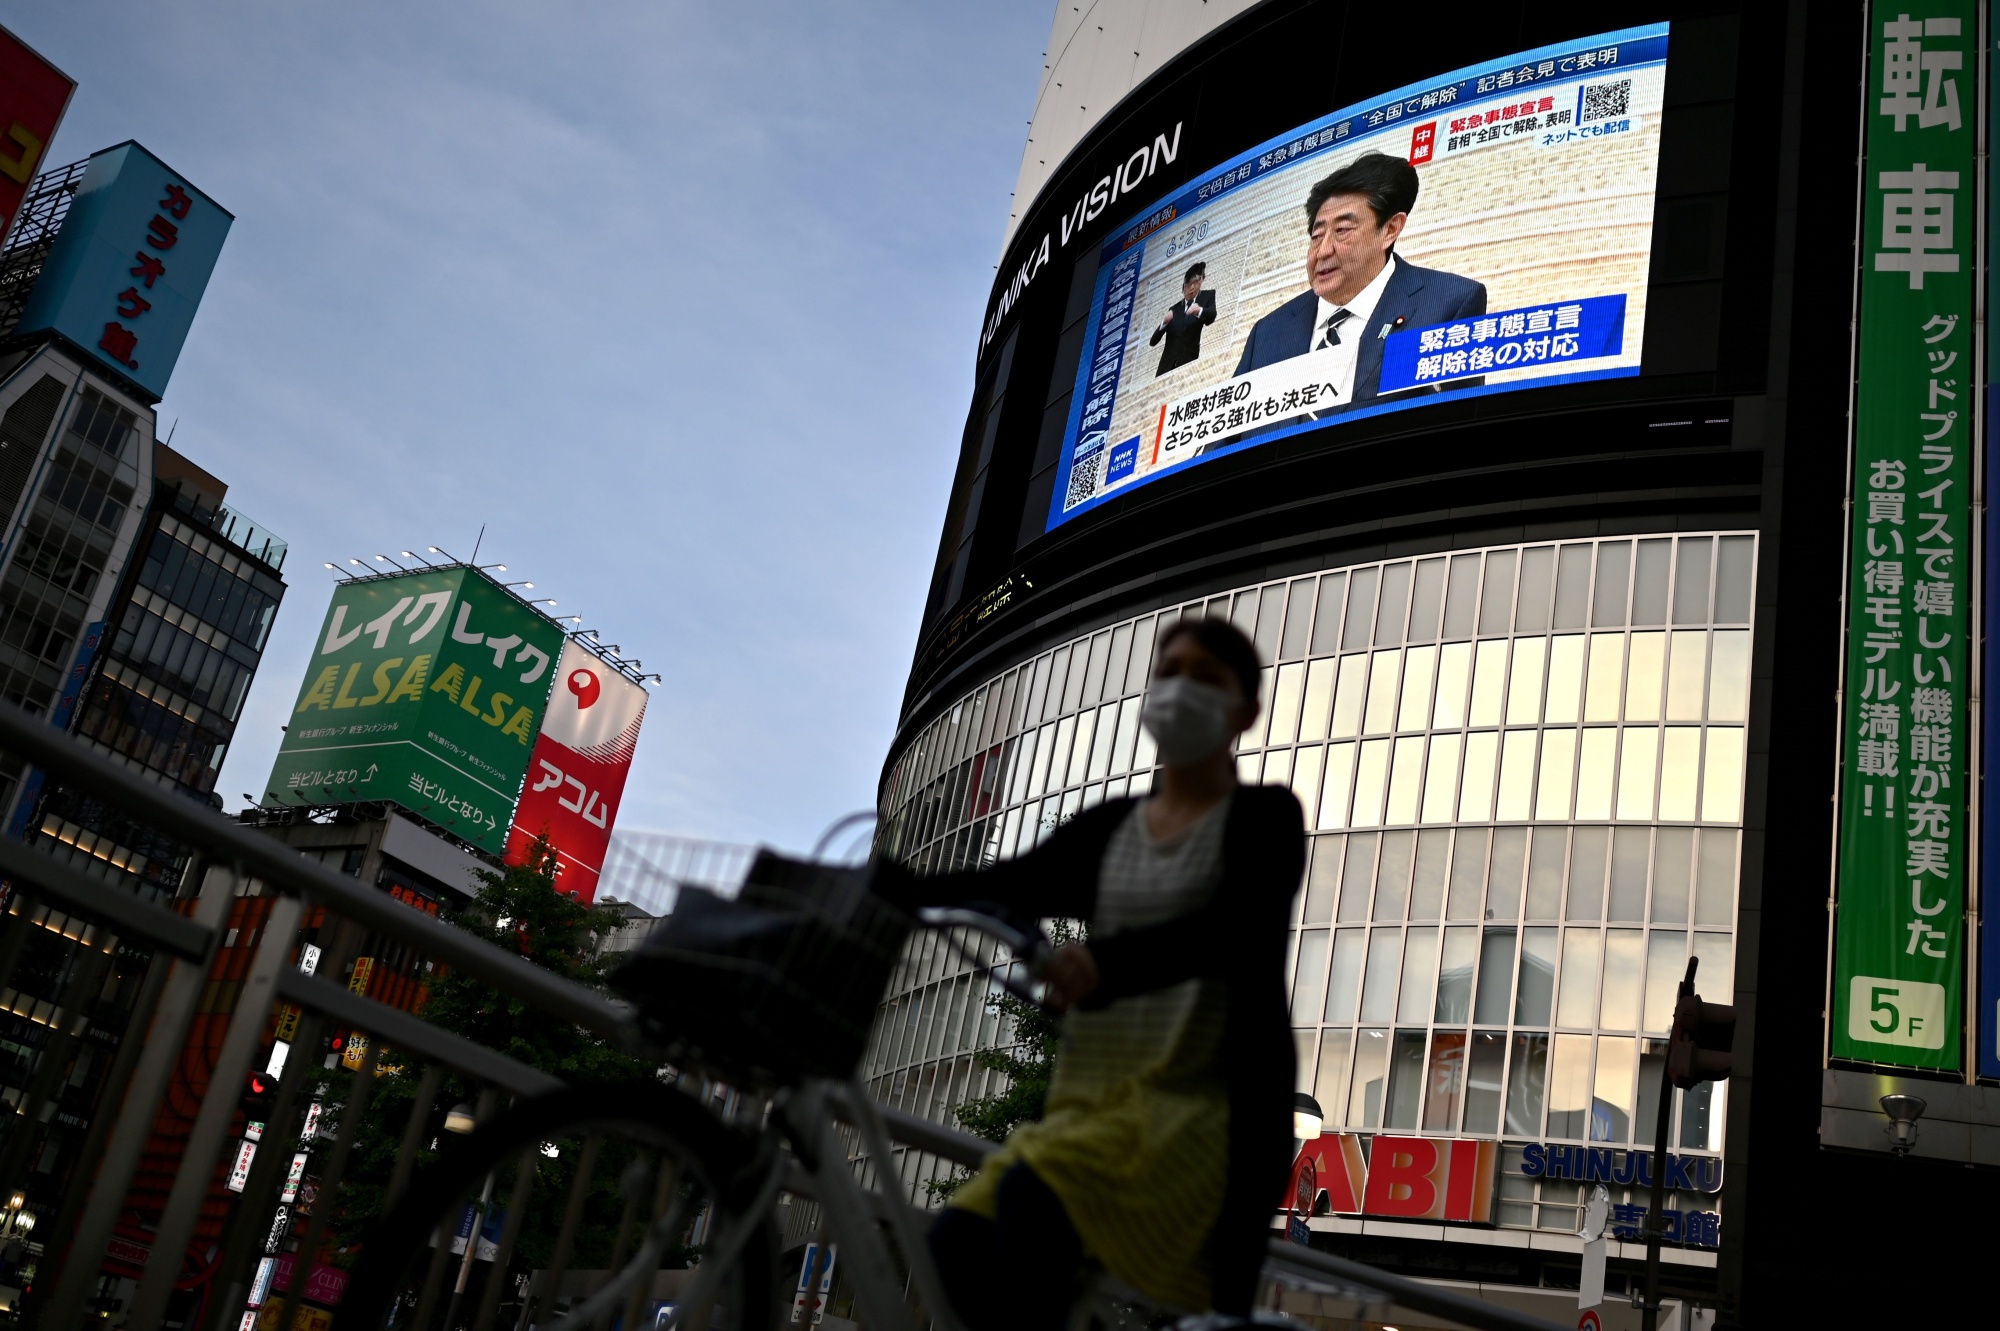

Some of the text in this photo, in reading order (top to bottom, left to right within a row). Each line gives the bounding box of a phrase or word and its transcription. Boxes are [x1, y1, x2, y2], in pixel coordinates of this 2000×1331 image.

[1197, 162, 1251, 203] 安倍首相
[1258, 121, 1351, 172] 緊急事態宣言
[1476, 47, 1618, 94] 記者会見で表明
[1450, 96, 1555, 134] 緊急事態宣言
[1542, 119, 1631, 146] ネットでも配信
[1412, 129, 1431, 159] 中継
[1875, 14, 1962, 290] 転車
[1061, 121, 1182, 248] VISION
[1166, 219, 1210, 259] 6:20
[1419, 303, 1583, 354] 緊急事態宣言
[1415, 335, 1579, 381] 解除後の対応
[1163, 382, 1339, 453] さらなる強化も決定へ
[1168, 380, 1251, 428] 水際対策の
[1110, 457, 1133, 473] NEWS
[1113, 448, 1133, 464] NHK
[321, 590, 452, 655] レイク
[451, 601, 550, 684] レイク
[1904, 314, 1959, 959] グッドプライスで嬉しい機能が充実した
[296, 654, 432, 713] ALSA
[430, 662, 533, 746] ALSA
[287, 766, 359, 788] 当ビルとなり
[408, 772, 484, 824] 当ビルとなり
[533, 758, 608, 830] アコム
[1869, 987, 1923, 1038] 5F
[1520, 1142, 1724, 1194] SHINJUKU
[1611, 1202, 1720, 1247] 東口館
